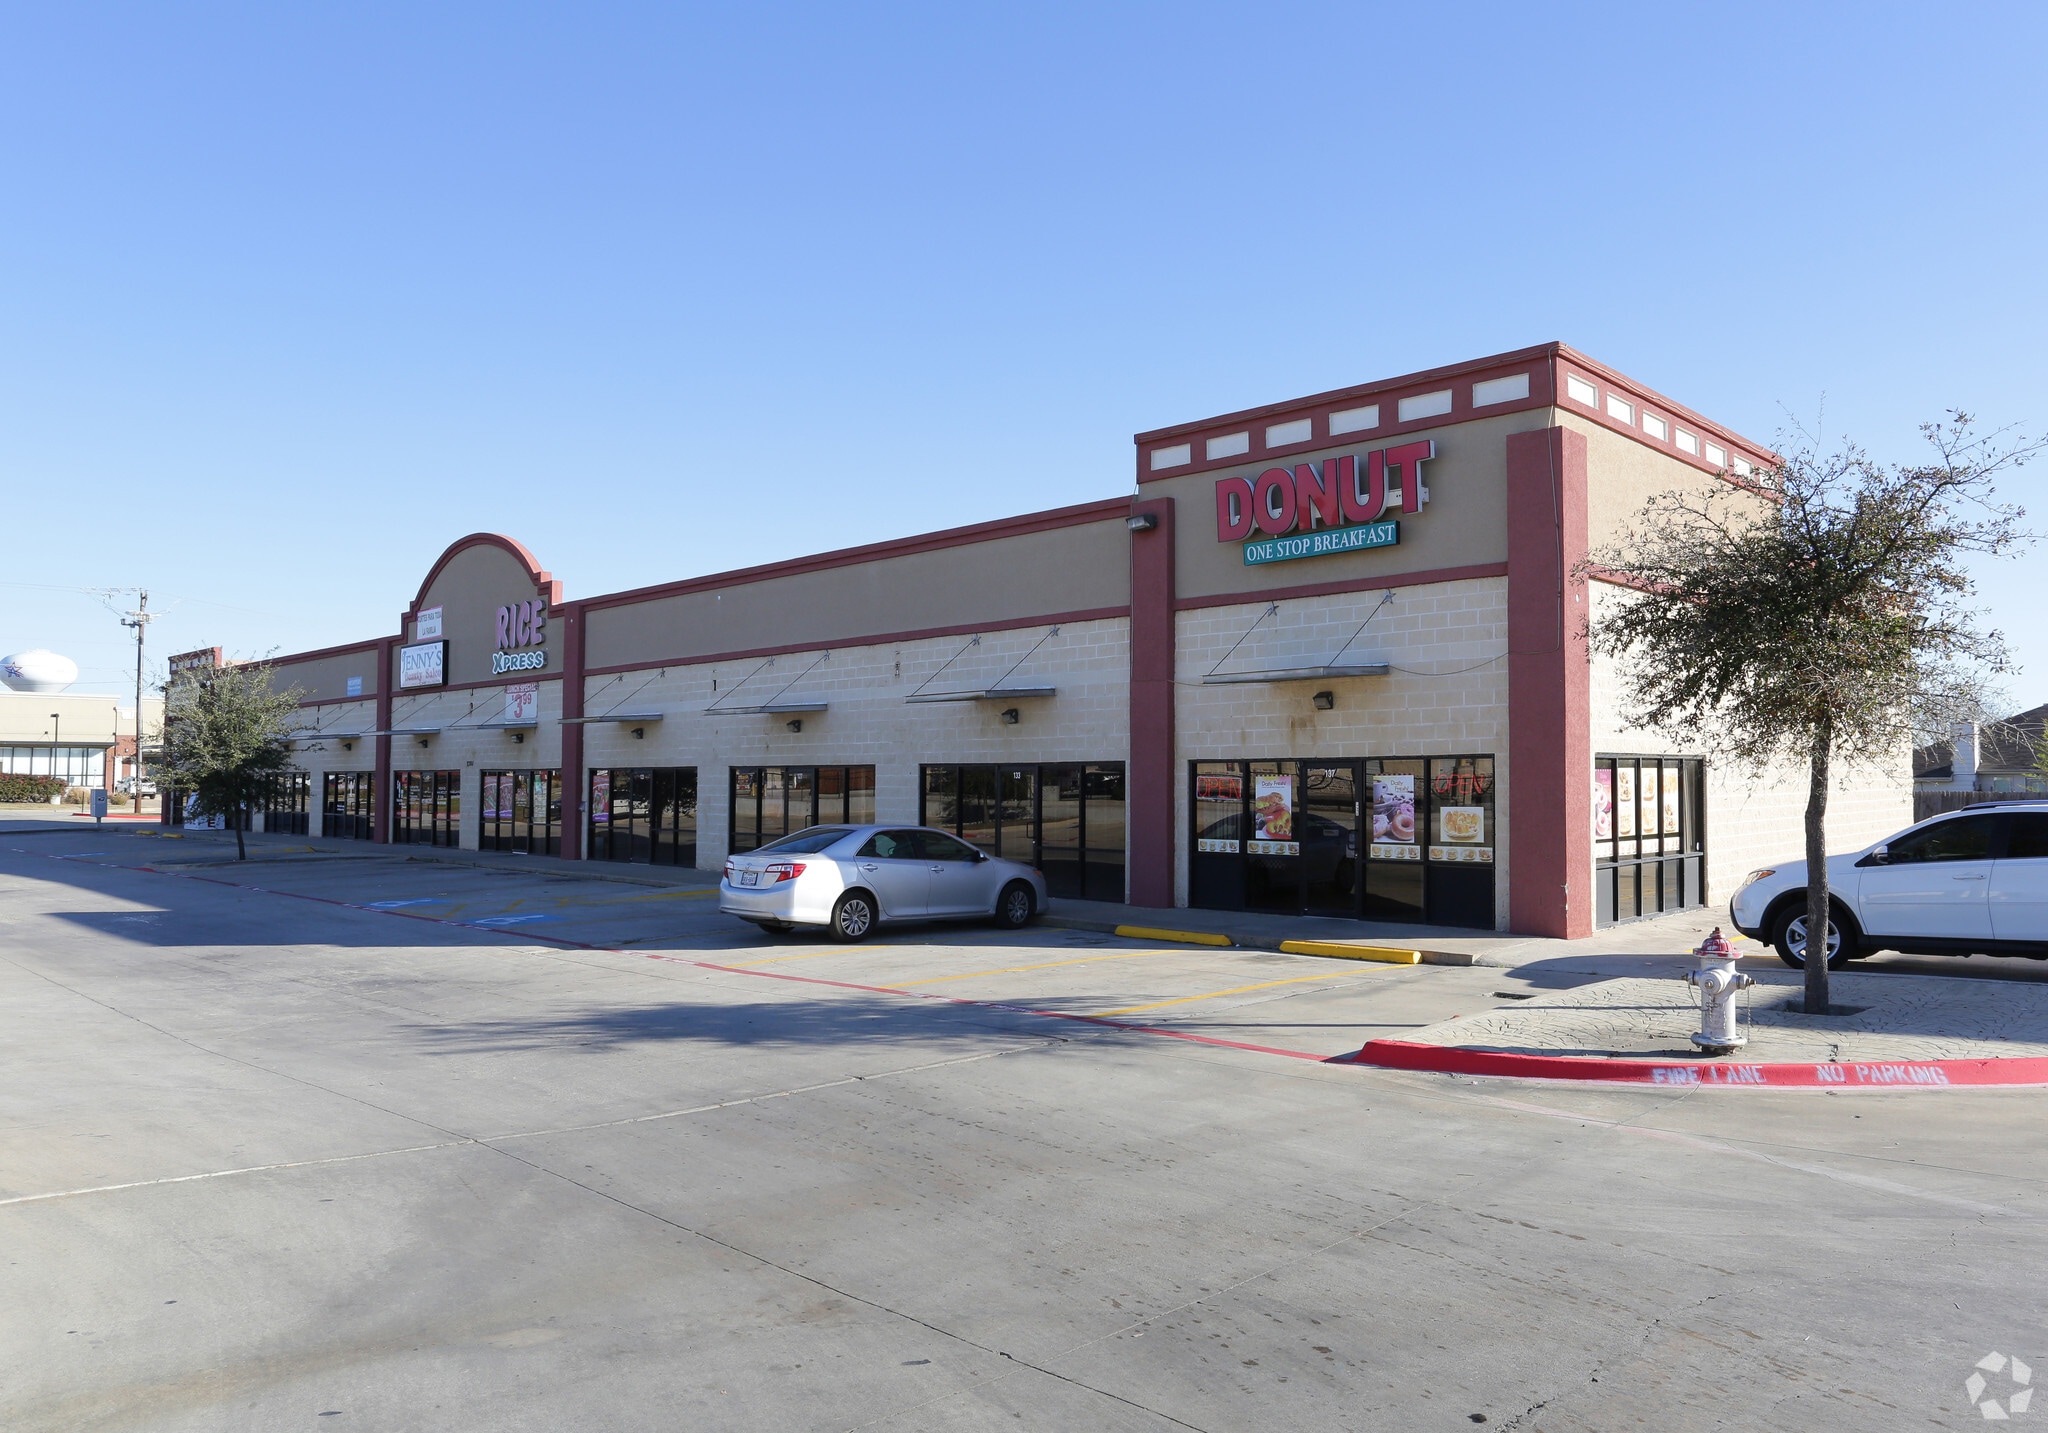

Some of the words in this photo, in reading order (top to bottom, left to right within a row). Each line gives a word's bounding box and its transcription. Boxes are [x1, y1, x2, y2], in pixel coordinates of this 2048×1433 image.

[1215, 440, 1434, 543] DONUT
[1247, 543, 1273, 561] ONE
[1277, 538, 1310, 557] STOP
[1313, 525, 1395, 551] BREAKFAST
[495, 600, 544, 649] RICE
[402, 645, 442, 673] JENNY'S
[492, 651, 544, 674] XPRESS
[1325, 768, 1336, 778] 137
[1435, 773, 1484, 795] OPEN
[1198, 777, 1242, 799] OPEN
[1652, 1066, 1700, 1084] FIRE
[1710, 1065, 1766, 1083] LANE
[1815, 1065, 1846, 1082] NO
[1855, 1065, 1949, 1085] PARKING
